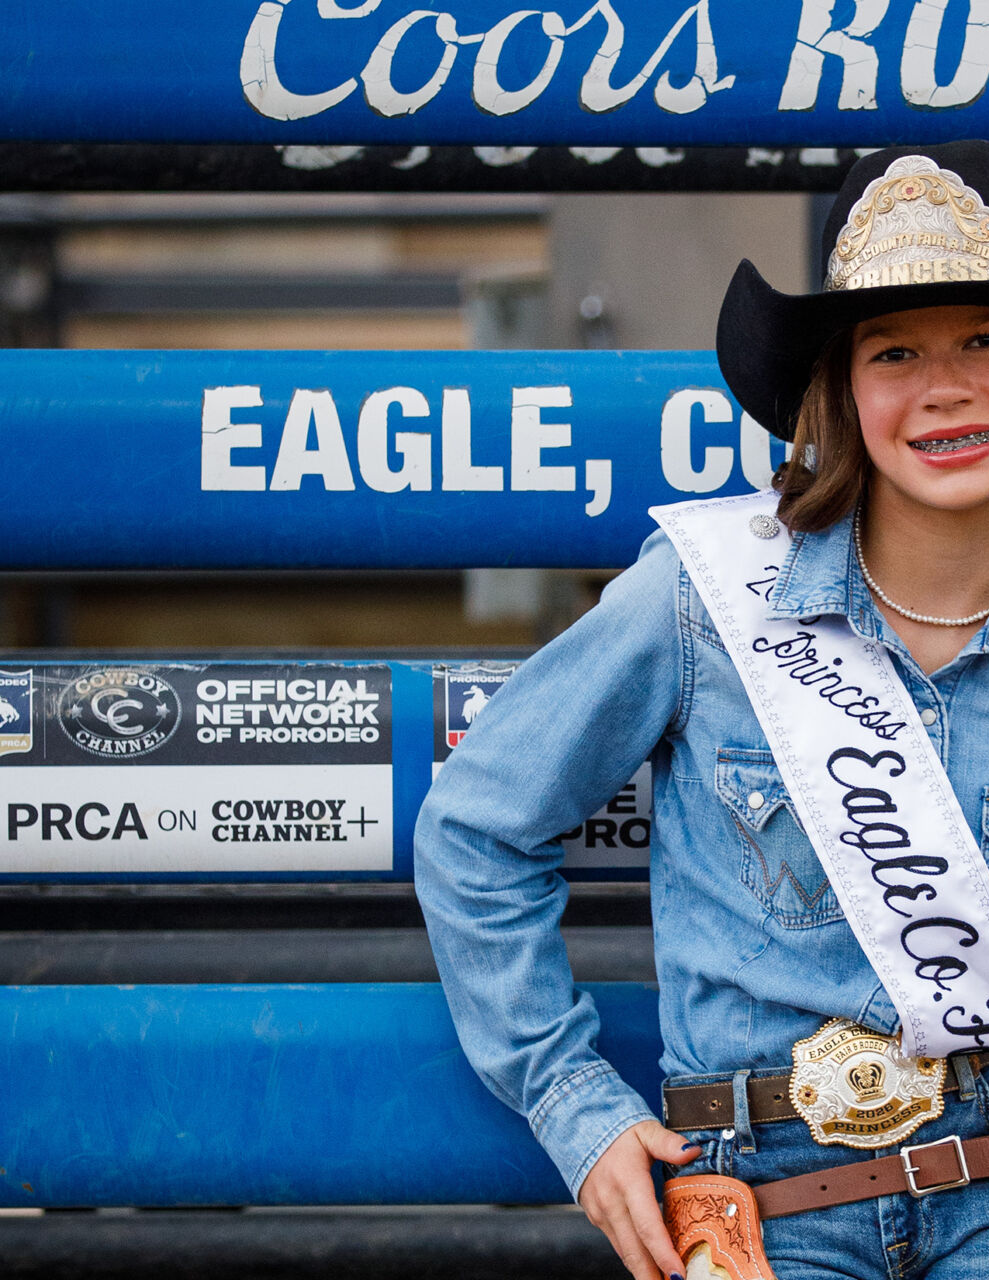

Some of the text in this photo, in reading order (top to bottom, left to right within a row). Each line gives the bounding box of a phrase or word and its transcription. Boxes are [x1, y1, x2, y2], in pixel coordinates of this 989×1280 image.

[239, 0, 737, 121] Coors
[862, 234, 914, 262] COUNTY
[917, 233, 947, 247] FAIR
[201, 386, 612, 517] EAGLE,
[76, 671, 169, 697] COWBOY
[196, 679, 379, 702] OFFICIAL
[752, 630, 908, 741] Princess
[197, 703, 379, 725] NETWORK
[76, 730, 166, 754] CHANNEL
[197, 727, 380, 743] OF PRORODEO
[7, 802, 197, 841] PRCA ON
[211, 799, 347, 821] COWBOY
[211, 823, 348, 842] CHANNEL
[826, 746, 949, 919] Eagle
[900, 916, 979, 1002] Co.
[808, 1031, 849, 1060] EAGLE
[835, 1043, 853, 1061] FAIR
[859, 1041, 884, 1051] RODEO
[832, 1102, 923, 1133] PRINCESS
[855, 1104, 895, 1120] 2026
